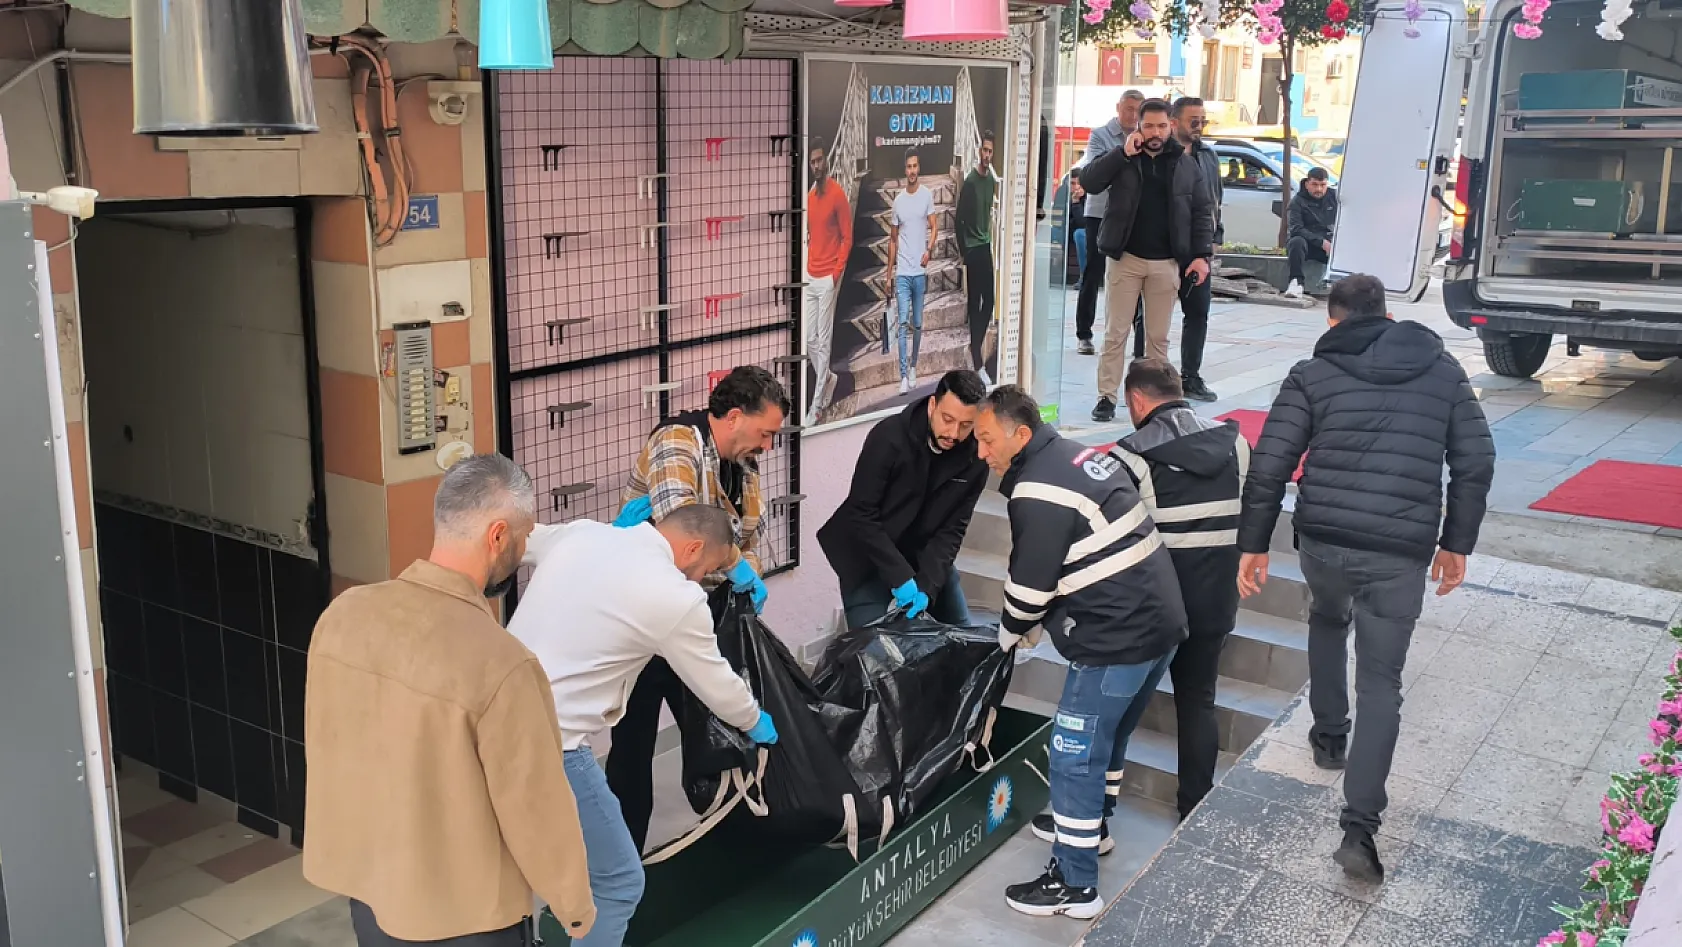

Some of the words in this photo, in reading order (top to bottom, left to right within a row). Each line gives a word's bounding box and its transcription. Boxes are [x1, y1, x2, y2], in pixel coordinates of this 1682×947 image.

[870, 84, 954, 104] KARİZMAN
[889, 112, 936, 133] GİYİM
[409, 204, 431, 225] 54
[860, 812, 952, 904] ANTALYA
[915, 819, 983, 895] BELEDİYESİ
